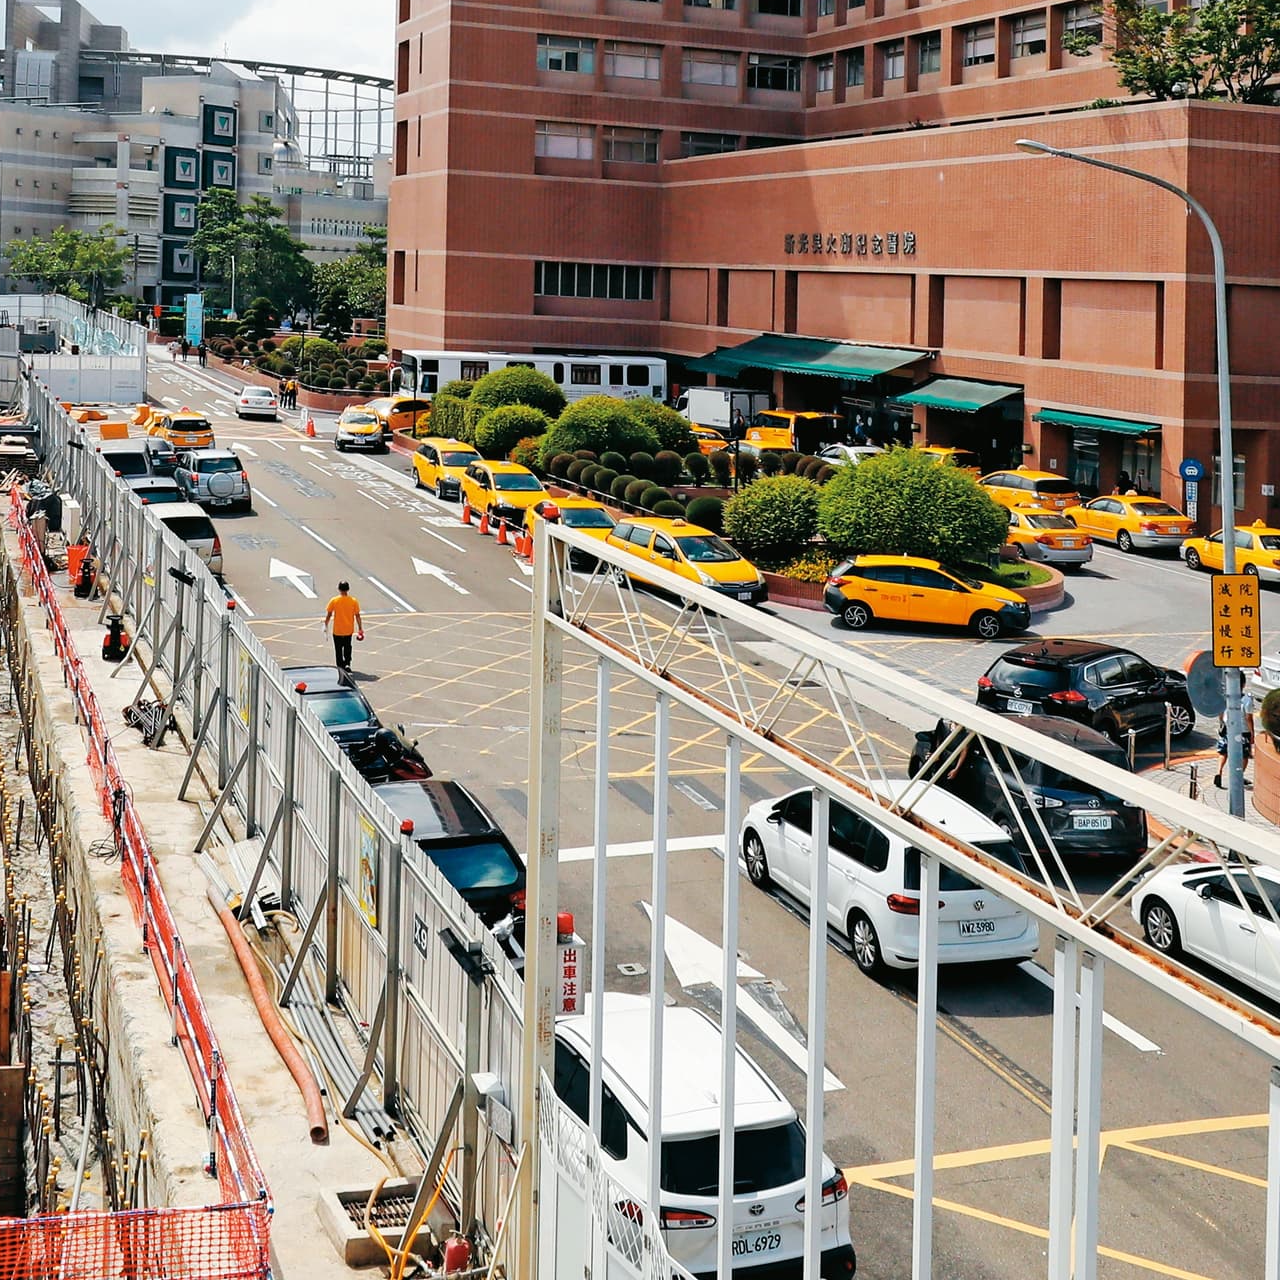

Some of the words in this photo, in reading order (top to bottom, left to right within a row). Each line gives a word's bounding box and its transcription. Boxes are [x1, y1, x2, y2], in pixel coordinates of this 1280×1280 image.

[1219, 583, 1234, 659] 減速慢行
[1240, 584, 1254, 658] 院內道路
[563, 948, 576, 1012] 出車注意
